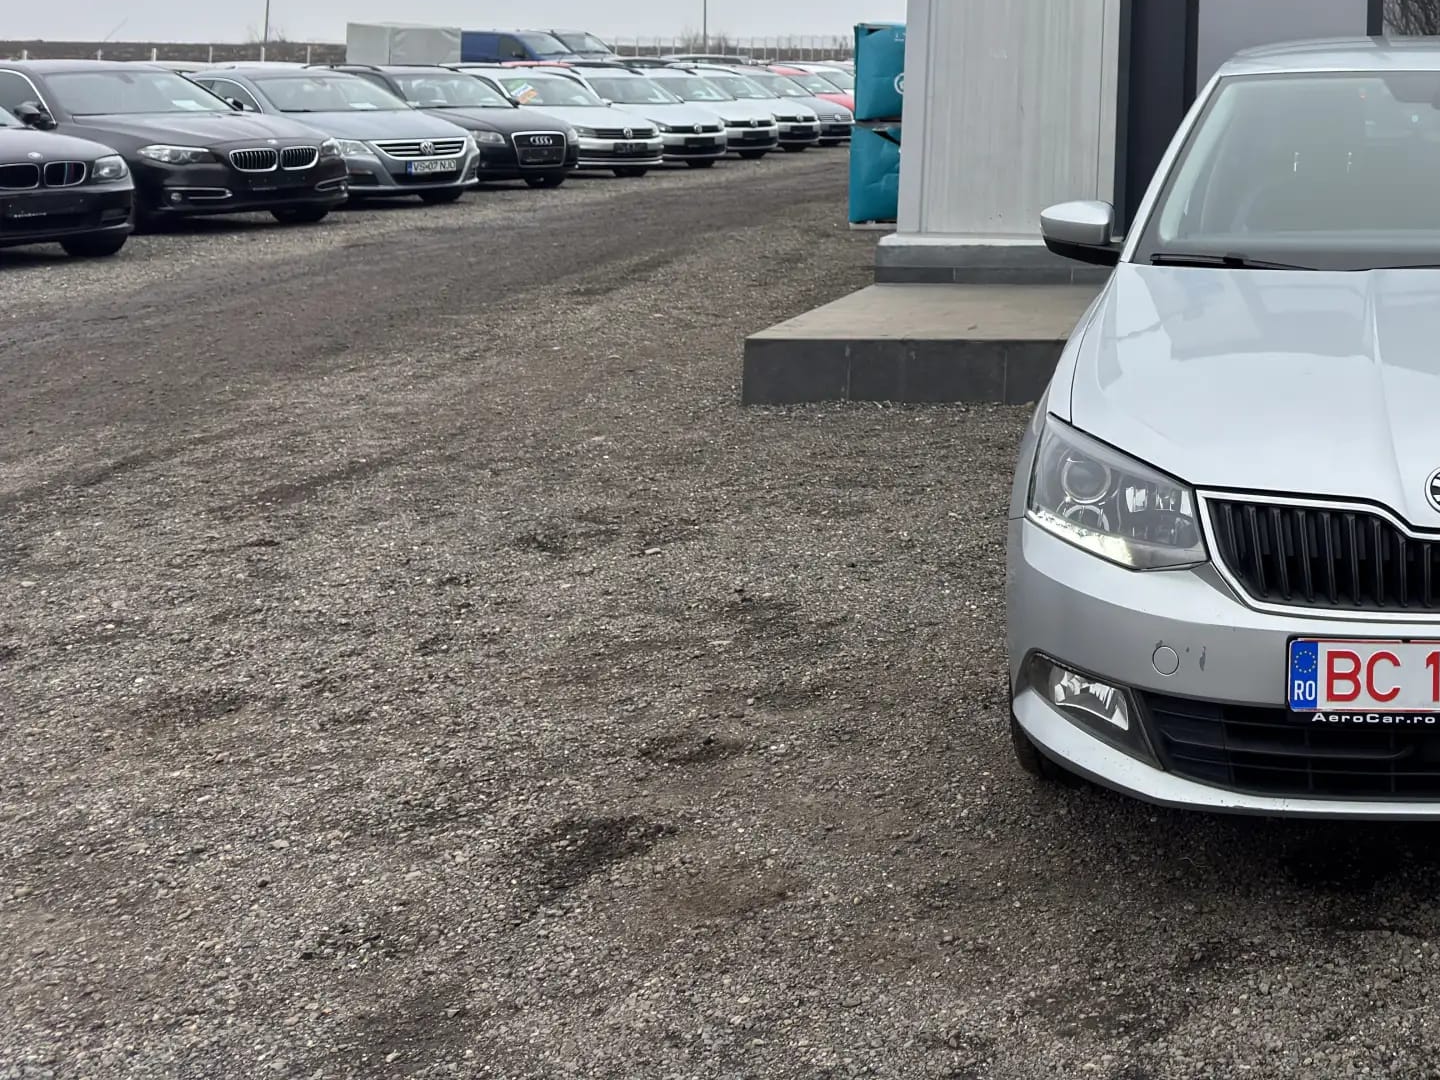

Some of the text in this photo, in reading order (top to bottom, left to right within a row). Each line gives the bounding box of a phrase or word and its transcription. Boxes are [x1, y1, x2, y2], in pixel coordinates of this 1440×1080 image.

[1326, 650, 1401, 703] BC
[1294, 680, 1316, 701] RO
[1312, 712, 1436, 724] AeroCar.ro
